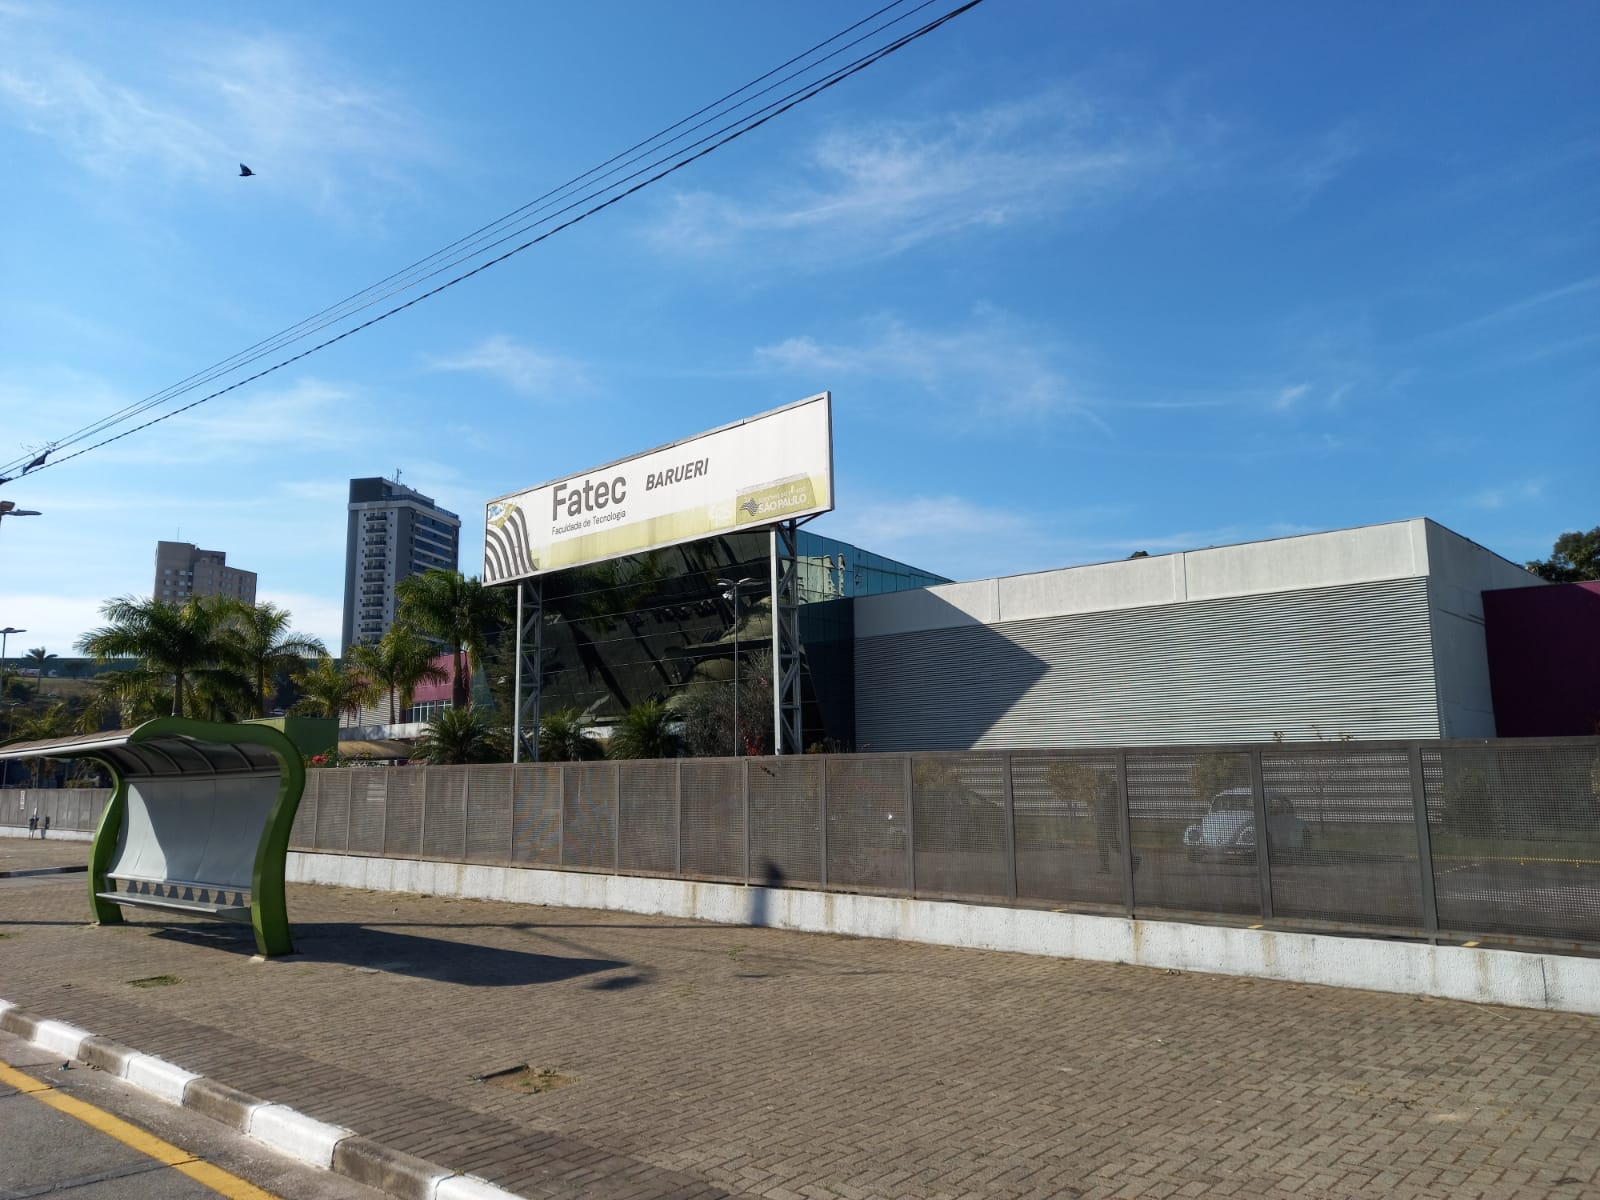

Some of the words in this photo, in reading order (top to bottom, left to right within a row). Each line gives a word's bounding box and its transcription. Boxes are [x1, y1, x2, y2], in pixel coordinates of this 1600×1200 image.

[646, 457, 709, 491] BARUERI
[552, 476, 626, 521] Fatec
[778, 494, 806, 510] PAULO
[551, 521, 582, 535] Faculdade
[583, 519, 591, 528] de
[593, 510, 626, 525] Tecnologia
